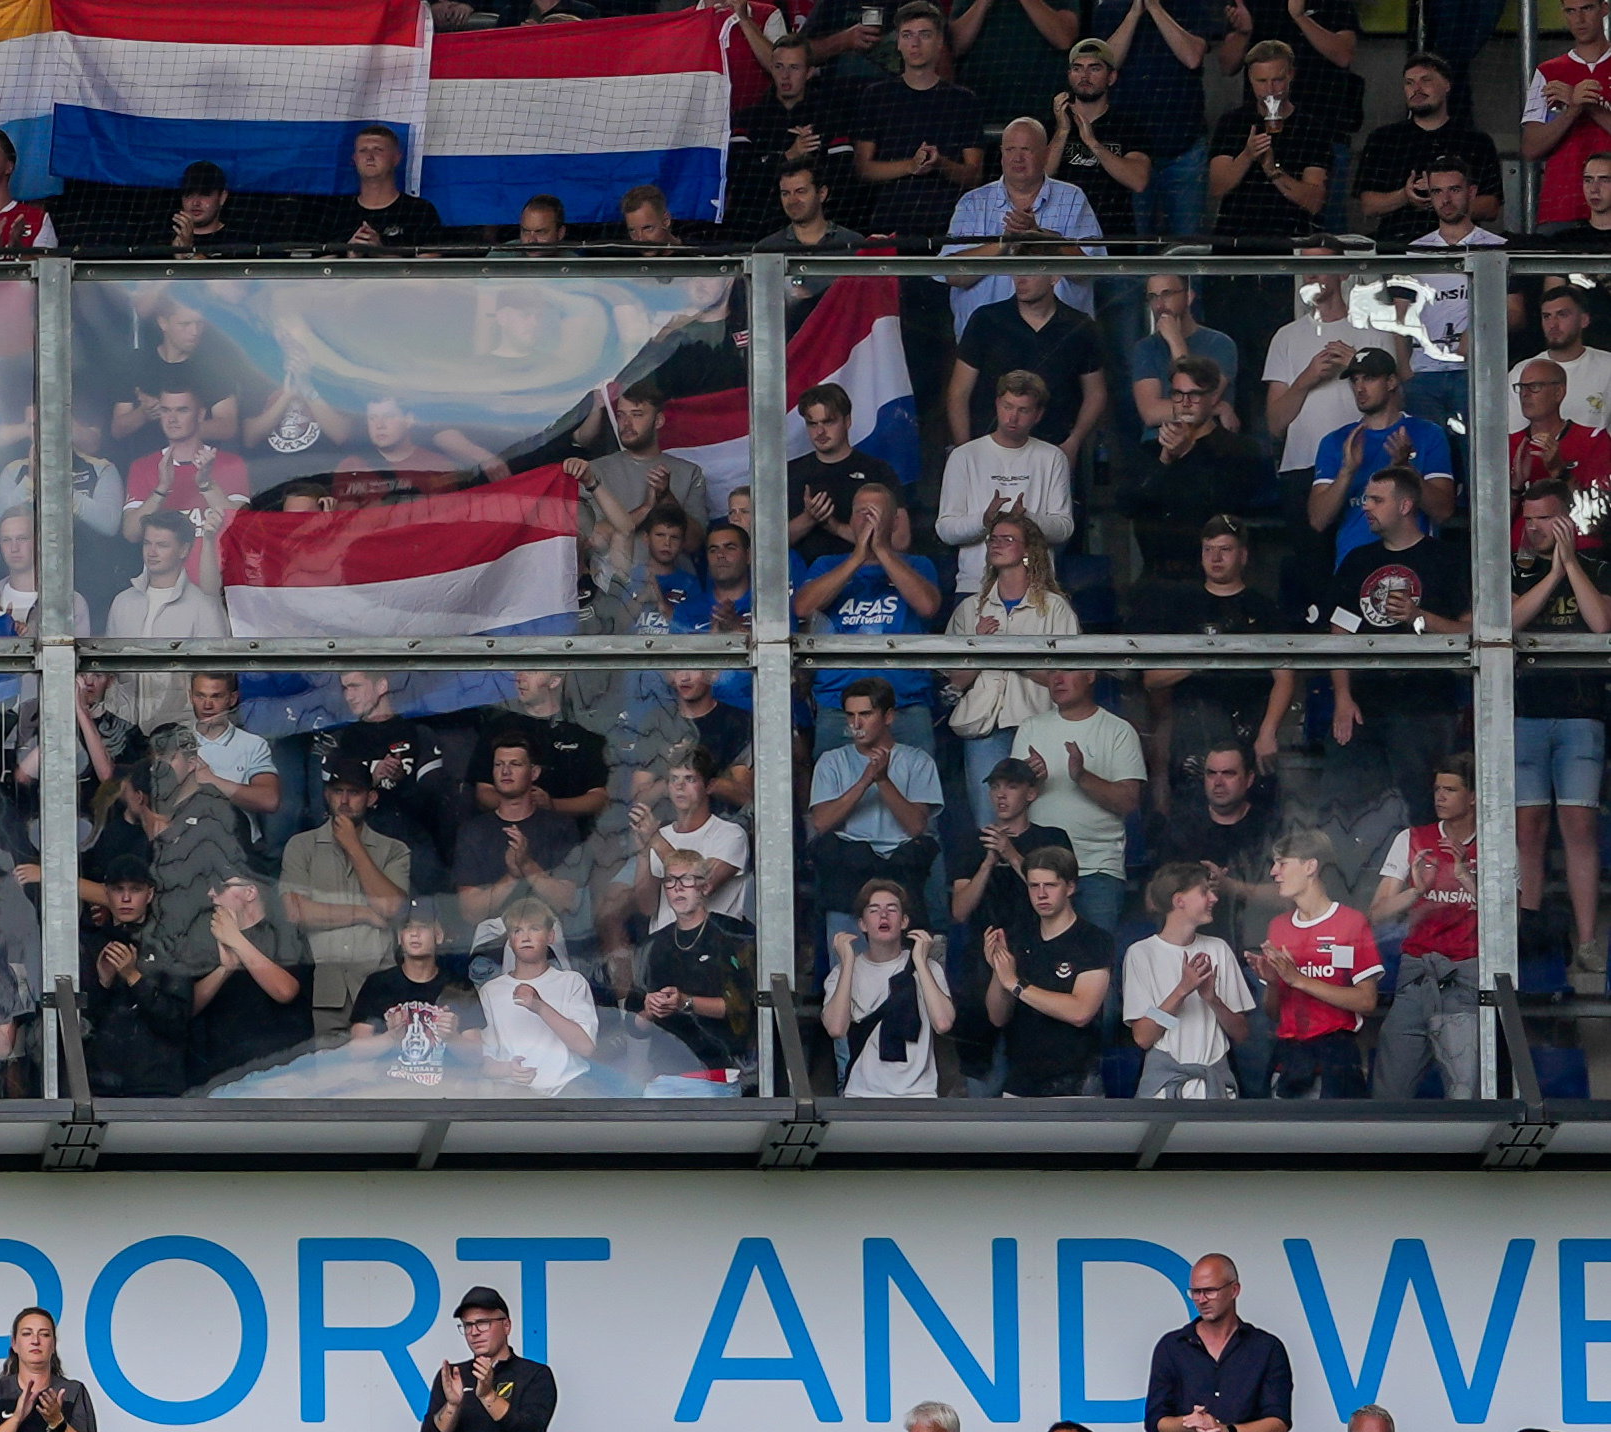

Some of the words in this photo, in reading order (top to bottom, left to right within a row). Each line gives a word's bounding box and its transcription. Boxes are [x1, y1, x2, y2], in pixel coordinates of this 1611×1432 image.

[838, 596, 899, 615] AFAS
[842, 613, 894, 625] software
[674, 1239, 1204, 1425] AND
